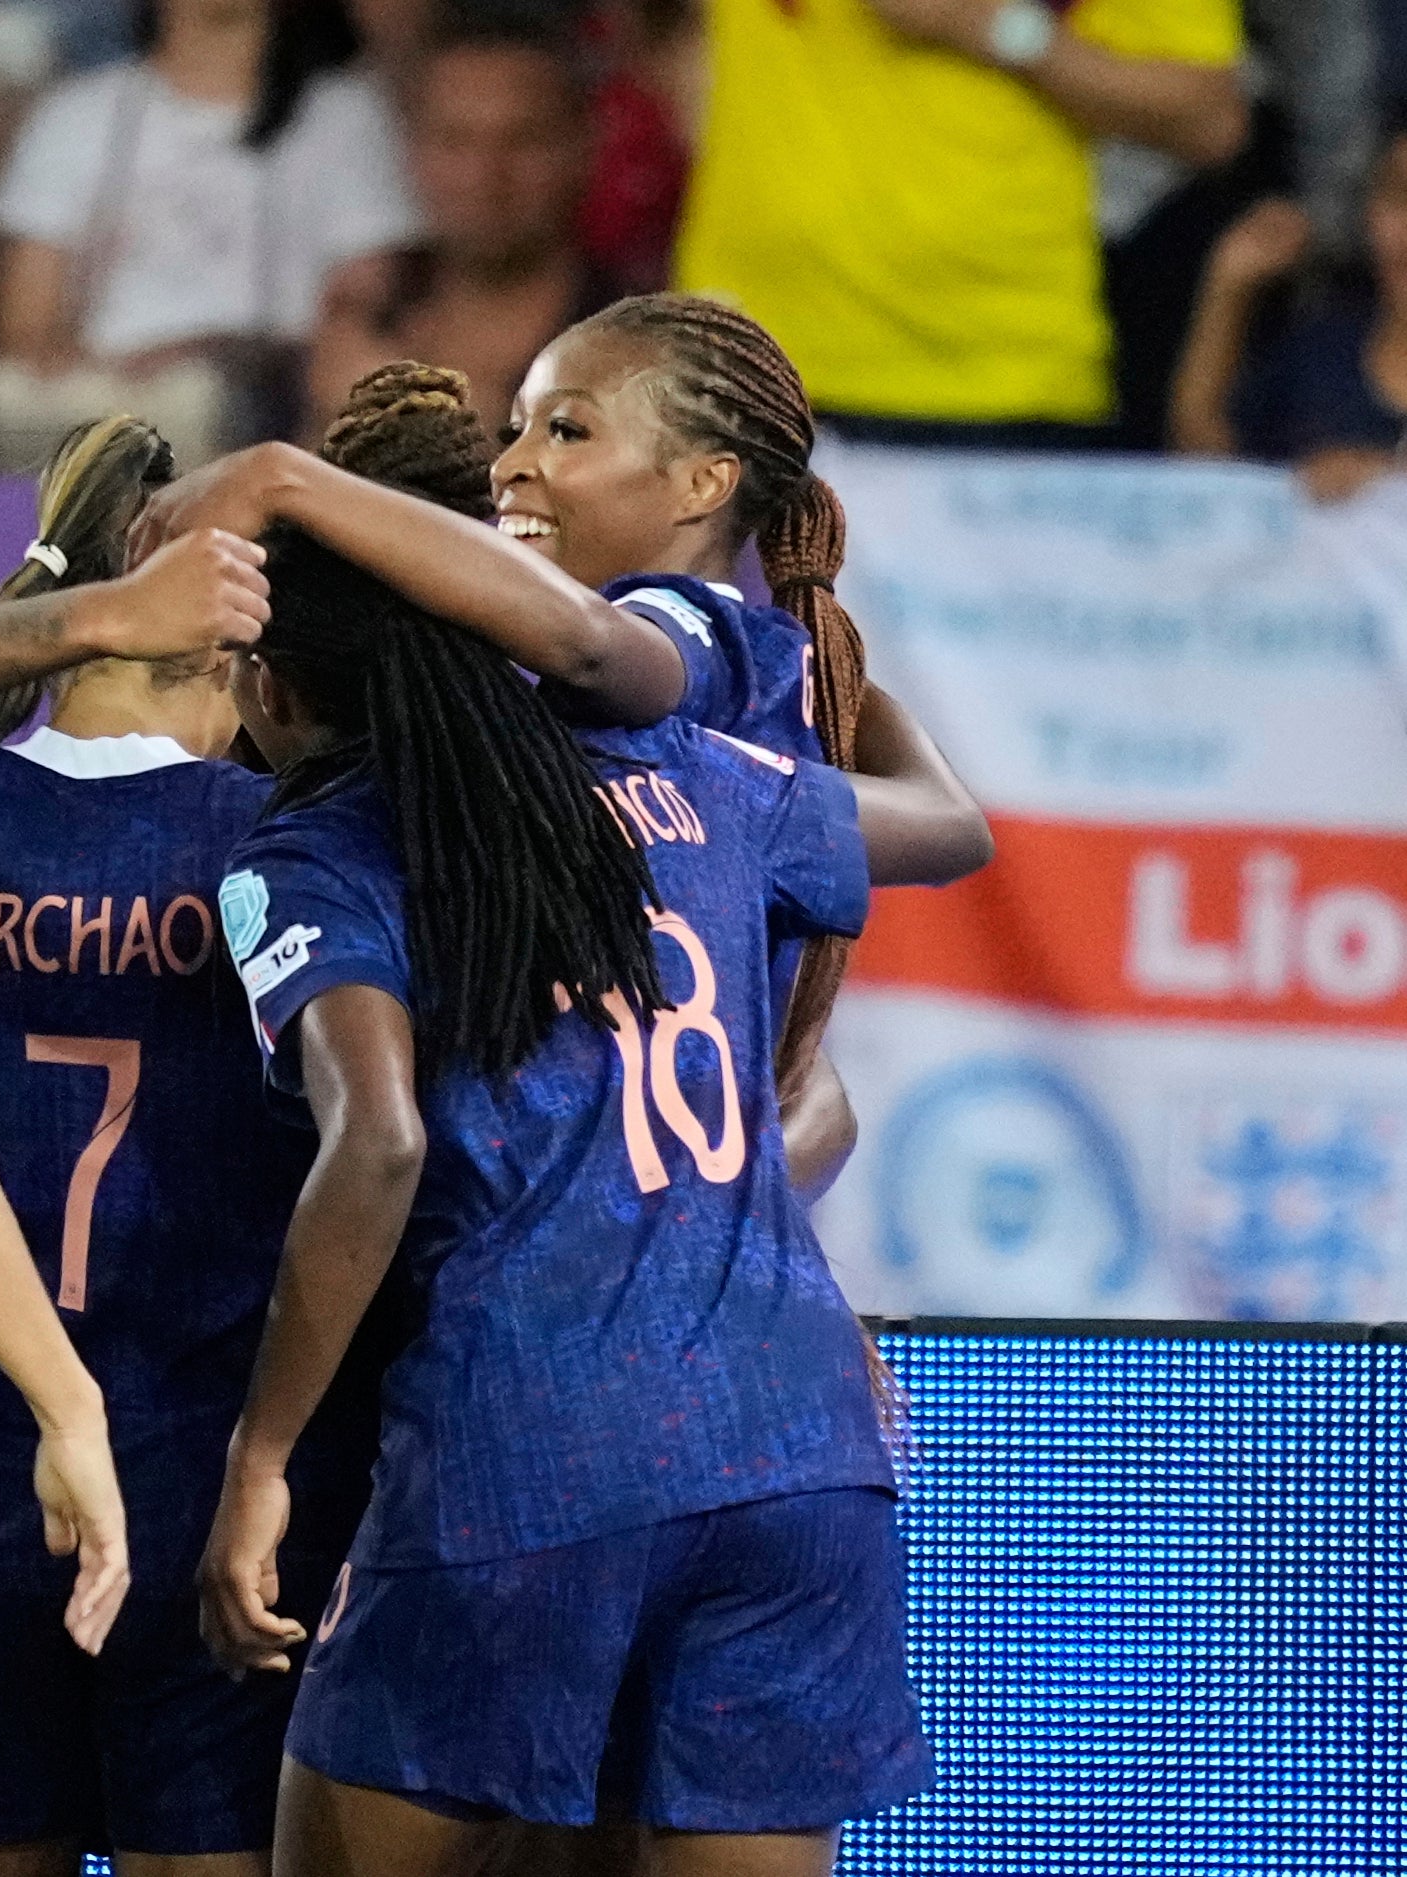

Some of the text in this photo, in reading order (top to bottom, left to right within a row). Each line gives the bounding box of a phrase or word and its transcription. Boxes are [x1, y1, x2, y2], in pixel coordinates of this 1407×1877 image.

[553, 905, 746, 1194] 18
[1126, 850, 1406, 1003] Lio
[25, 1032, 141, 1312] 7
